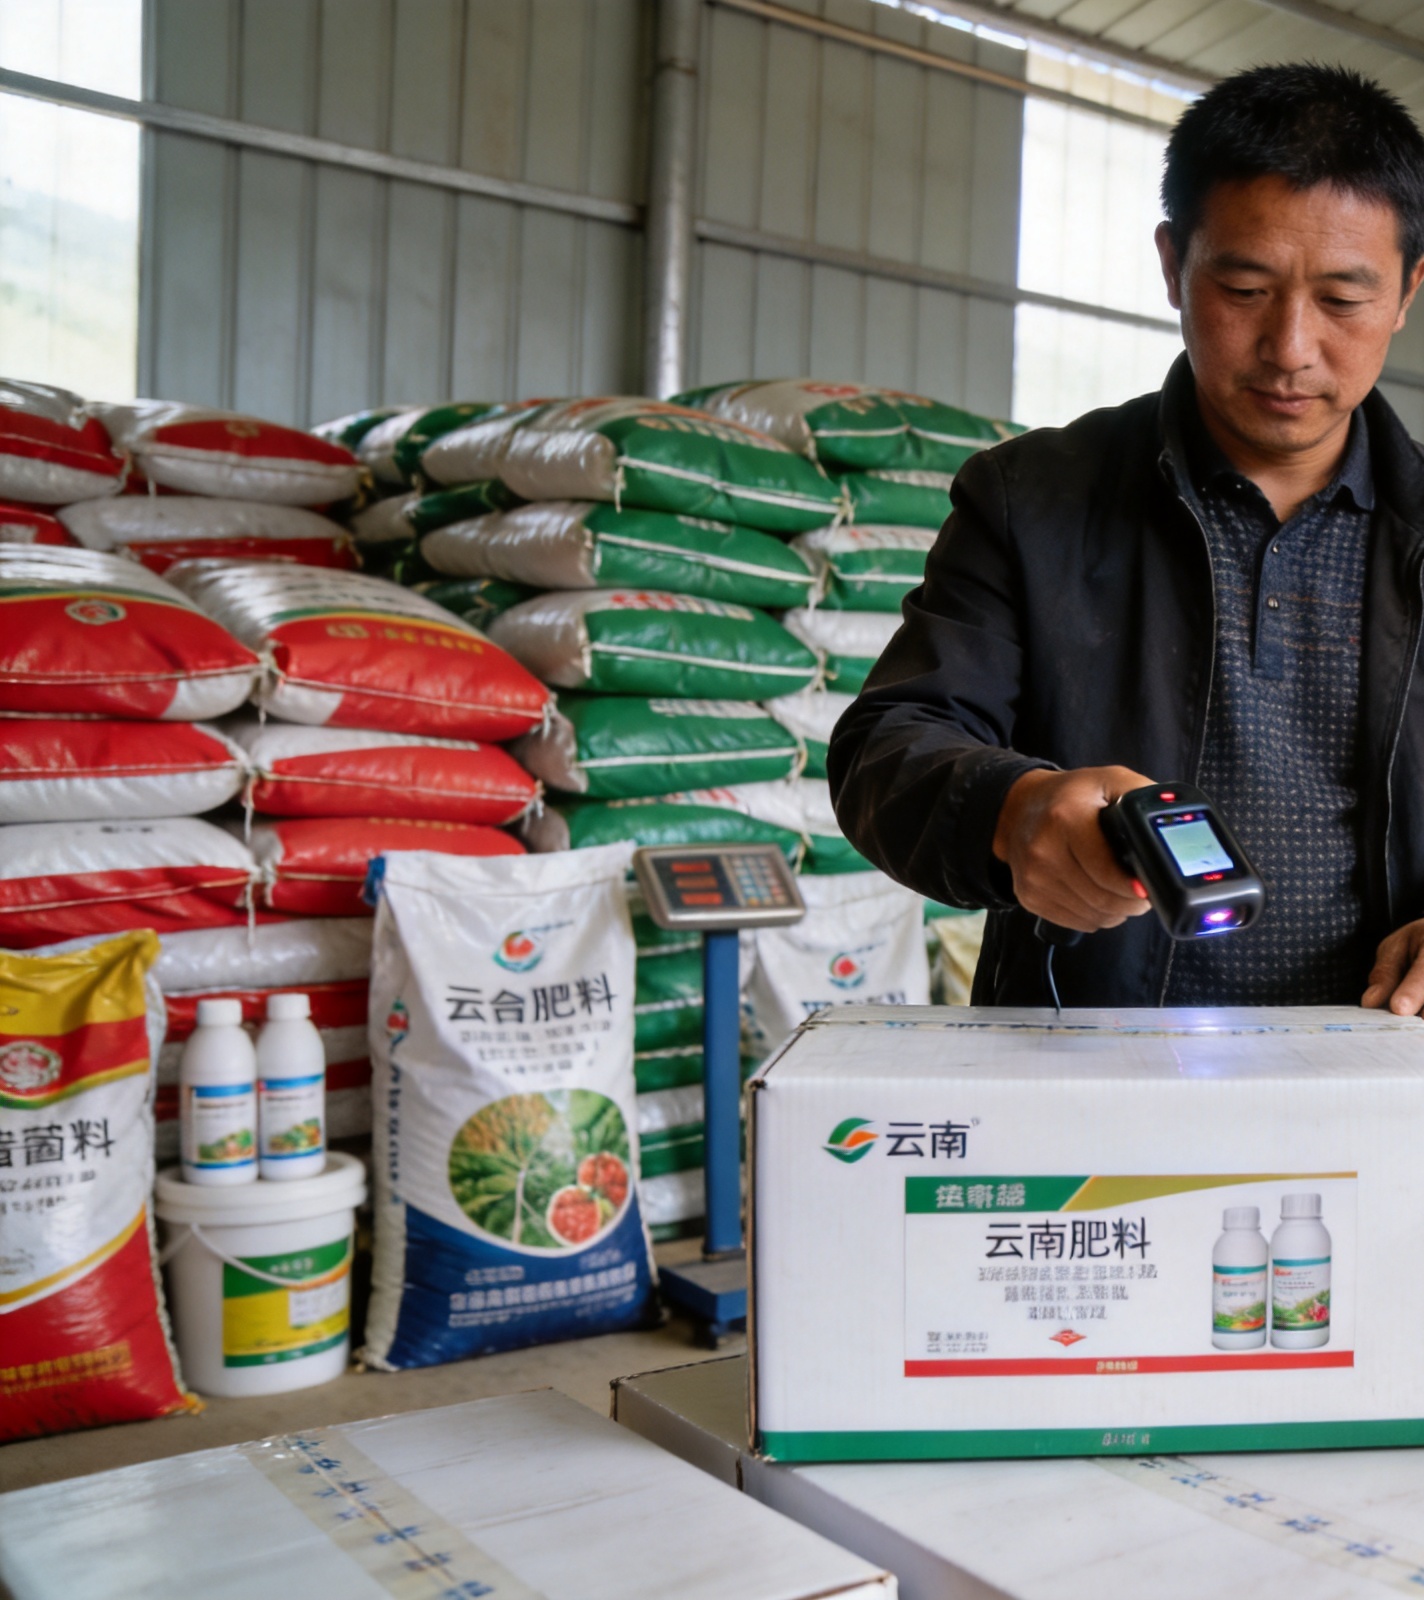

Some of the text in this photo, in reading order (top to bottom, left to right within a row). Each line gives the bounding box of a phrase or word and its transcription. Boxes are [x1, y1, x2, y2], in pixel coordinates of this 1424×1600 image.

[446, 973, 617, 1024] 云合肥料
[886, 1120, 970, 1159] 云南
[985, 1217, 1151, 1260] 云南肥料
